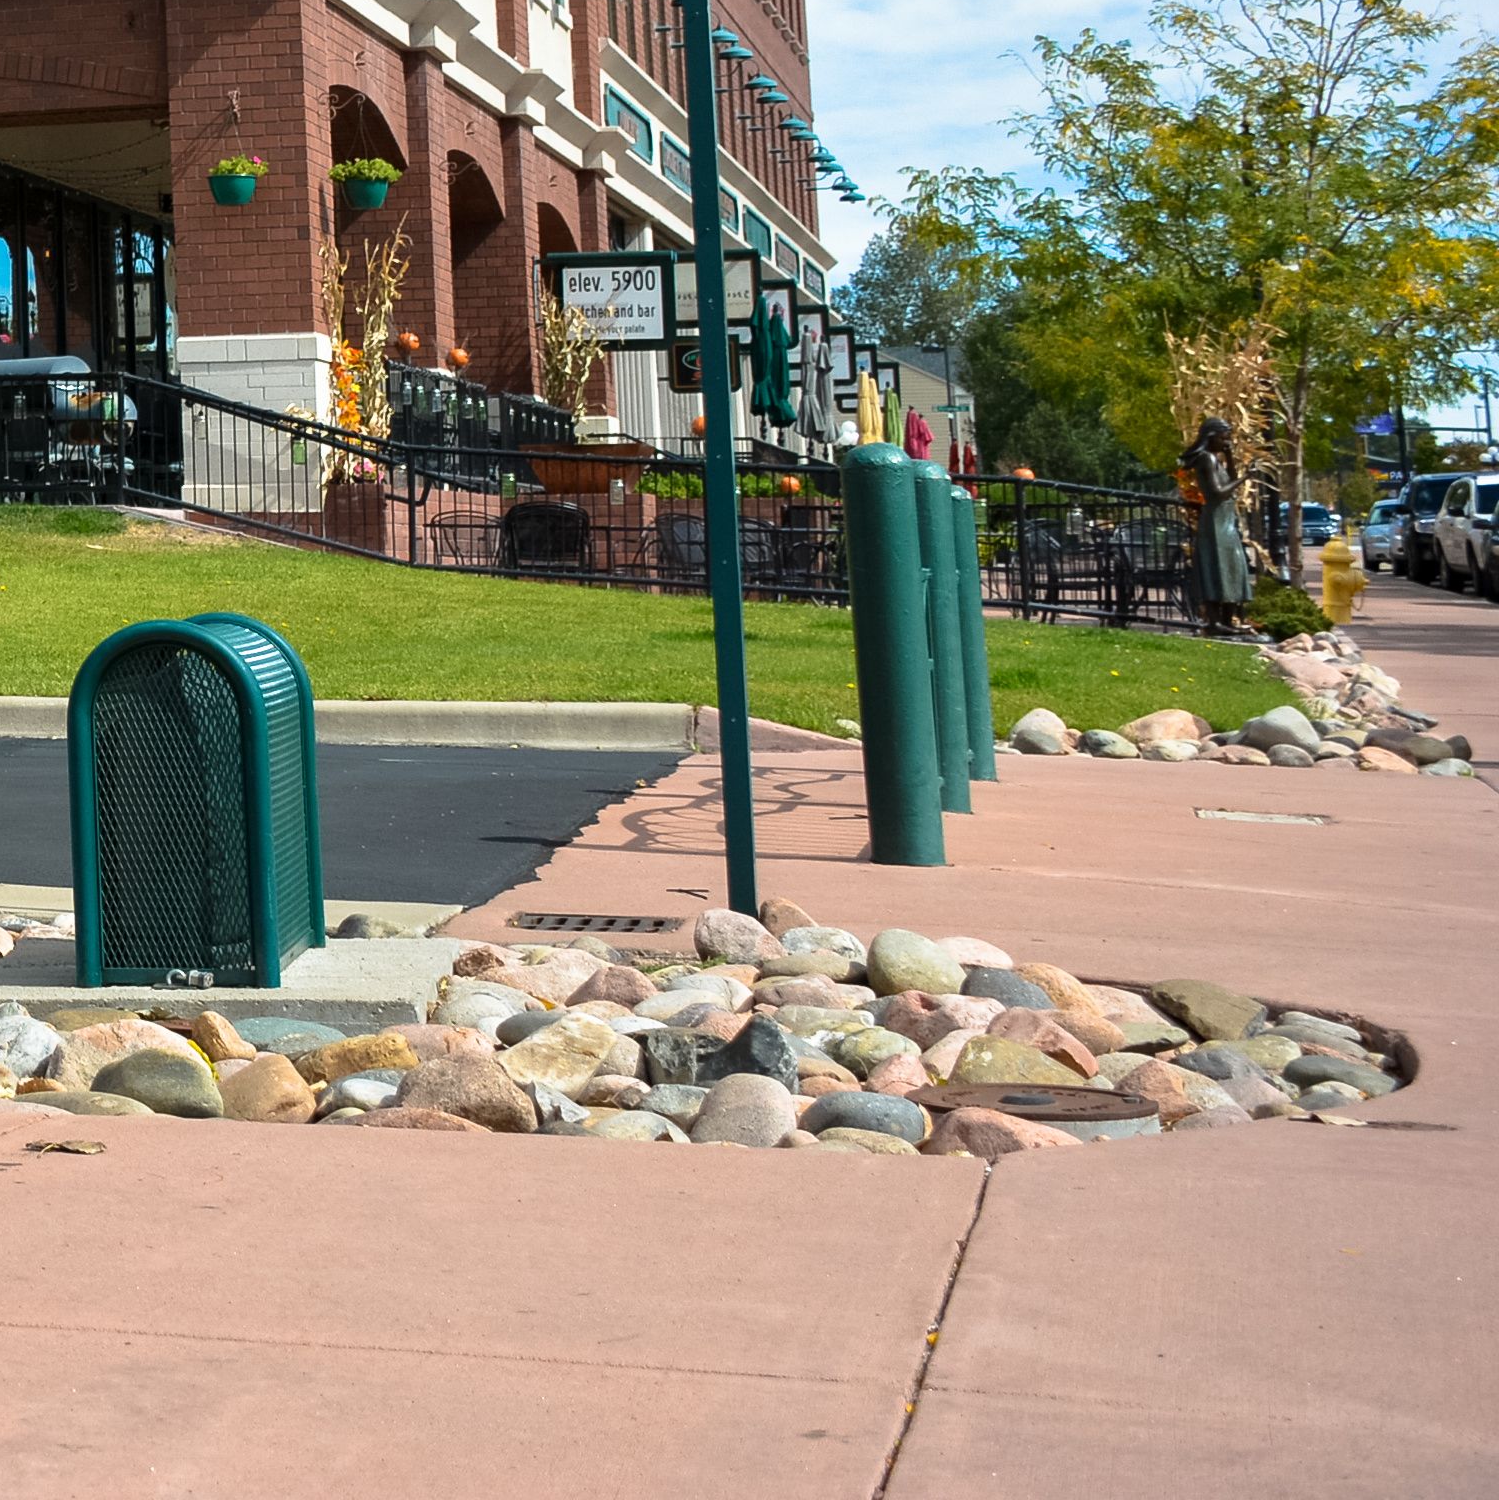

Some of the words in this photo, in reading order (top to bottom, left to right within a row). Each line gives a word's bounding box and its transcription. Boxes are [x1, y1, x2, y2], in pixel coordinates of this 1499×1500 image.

[569, 272, 604, 292] elev.
[611, 270, 656, 292] 5900
[637, 304, 656, 318] bar
